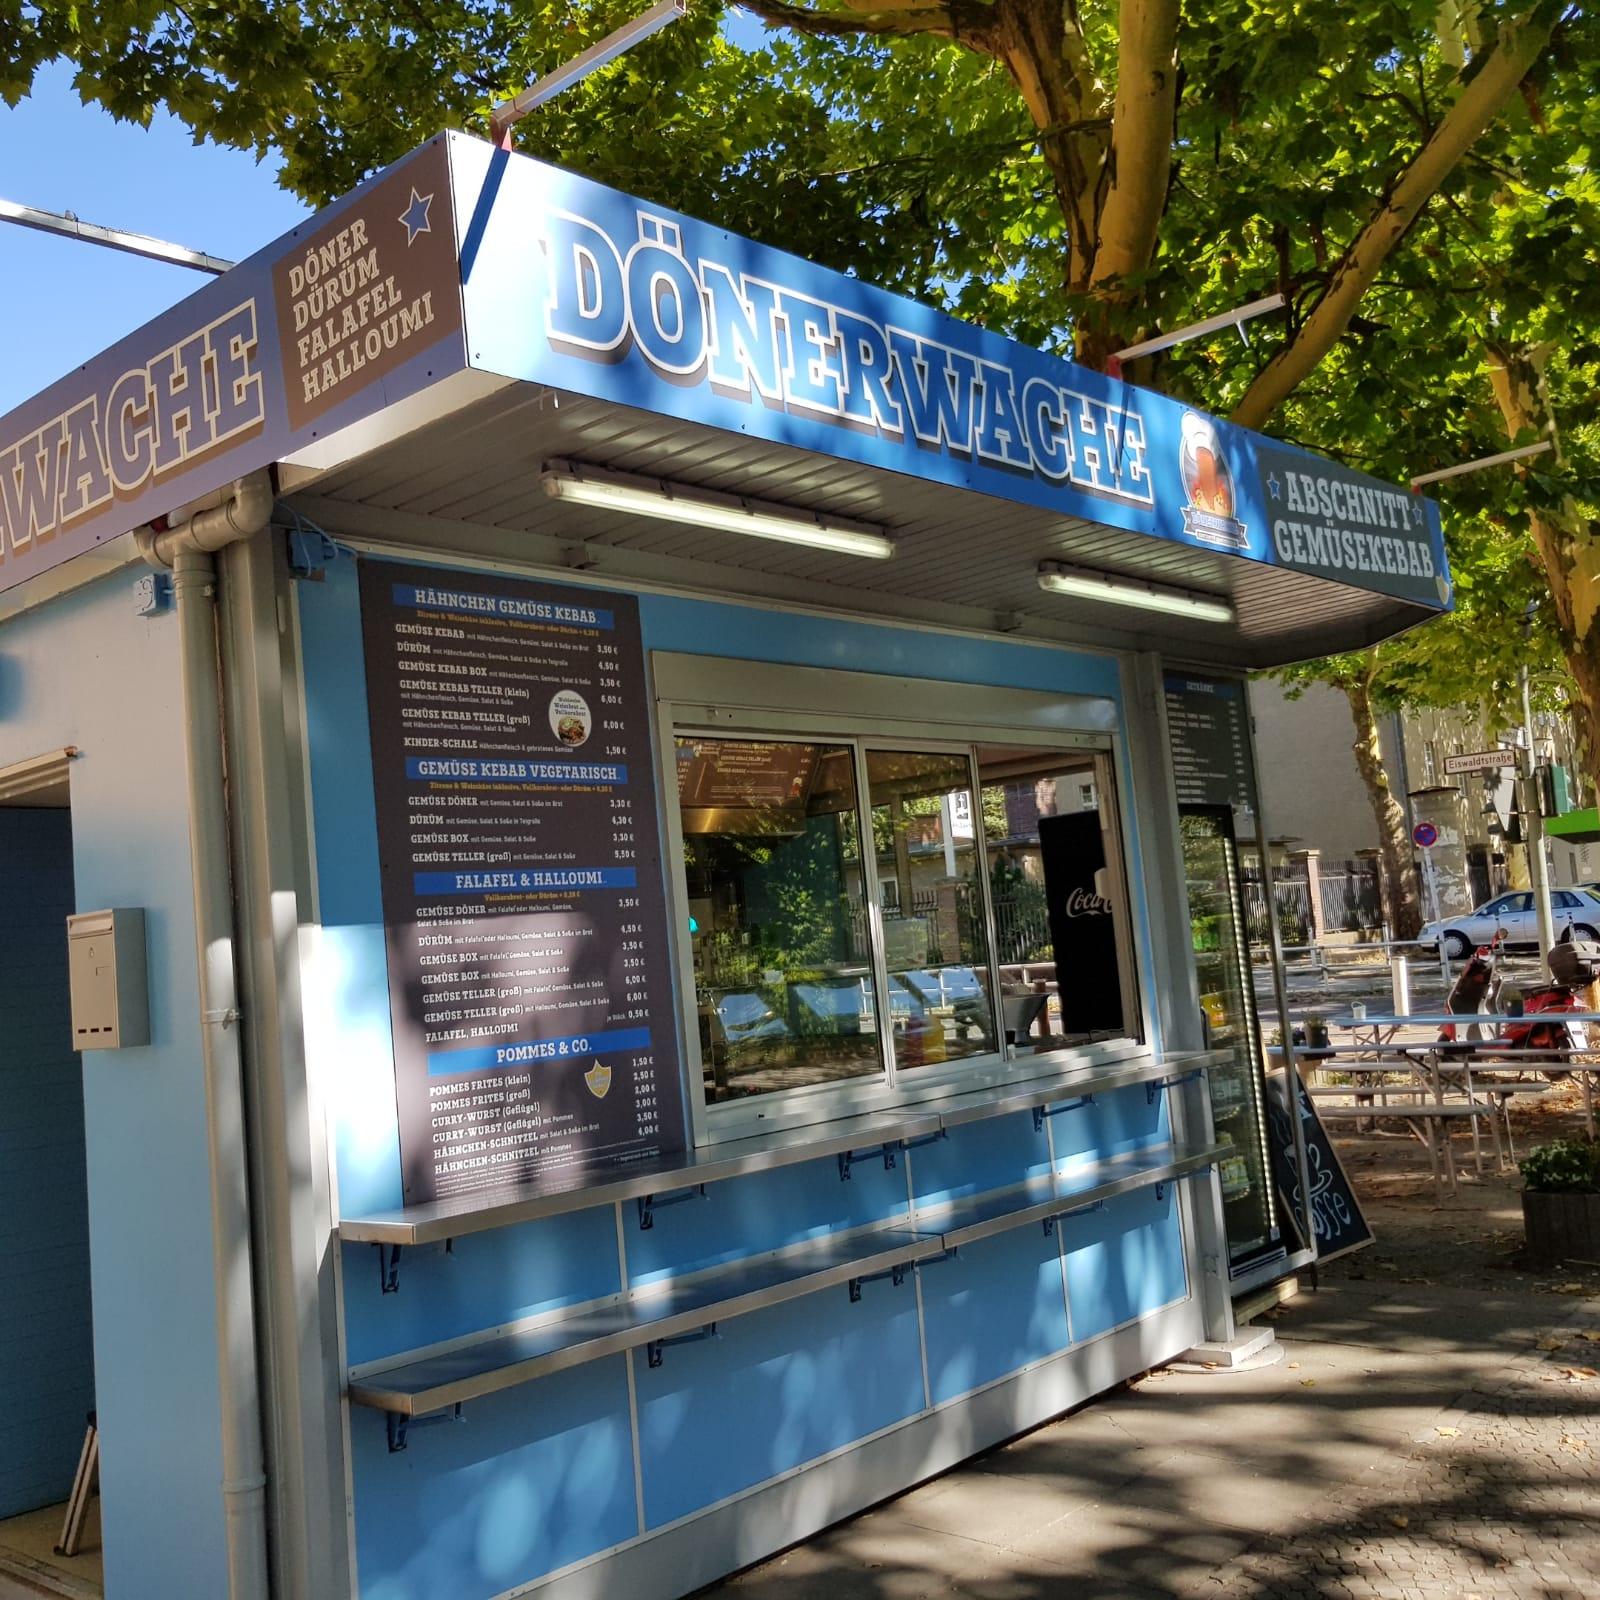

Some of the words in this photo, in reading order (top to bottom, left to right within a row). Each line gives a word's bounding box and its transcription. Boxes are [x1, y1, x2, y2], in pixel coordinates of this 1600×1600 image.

[288, 218, 369, 297] DÖNER
[292, 248, 380, 332] DÜRÜM
[297, 276, 402, 367] FALAFEL
[302, 291, 435, 404] HALLOUMI
[543, 210, 1154, 505] DÖNERWACHE
[0, 298, 265, 556] WACHE
[1285, 472, 1411, 531] ABSCHNITT
[1274, 519, 1434, 578] GEMÜSEKEBAB
[415, 587, 496, 611] HÄHNCHEN
[499, 597, 552, 618] GEMÜSE
[554, 607, 597, 624] KEBAB
[395, 622, 433, 636] GEMÜSE
[435, 628, 465, 639] KEBAB
[397, 641, 431, 654] DÜRÜM
[597, 645, 612, 654] 3,50
[398, 660, 436, 672] GEMÜSE
[438, 665, 468, 675] KEBAB
[469, 667, 488, 676] BOX
[598, 662, 613, 671] 4,50
[399, 678, 437, 691] GEMÜSE
[439, 683, 469, 693] KEBAB
[470, 685, 503, 695] TELLER
[504, 688, 529, 699] (klein)
[600, 678, 615, 688] 3,50
[402, 707, 439, 719] GEMÜSE
[441, 711, 471, 721] KEBAB
[473, 712, 505, 722] TELLER
[507, 715, 530, 726] (groß)
[404, 737, 478, 749] KINDER-SCHALE
[606, 747, 621, 756] 1,50
[1449, 753, 1512, 769] Eiswaldtstraße
[418, 759, 478, 776] GEMÜSE
[481, 763, 527, 777] KEBAB
[529, 765, 617, 780] VEGETARISCH
[408, 795, 446, 806] GEMÜSE
[448, 795, 478, 806] DÖNER
[410, 814, 444, 824] DÜRÜM
[411, 832, 449, 843] GEMÜSE
[451, 834, 469, 843] BOX
[412, 851, 450, 862] GEMÜSE
[452, 852, 485, 861] TELLER
[487, 853, 511, 862] (groß)
[455, 874, 517, 889] FALAFEL
[520, 874, 530, 886] &
[533, 871, 603, 886] HALLOUMI
[416, 905, 454, 917] GEMÜSE
[456, 904, 486, 915] DÖNER
[619, 899, 634, 908] 3,50
[419, 935, 453, 946] DÜRÜM
[622, 942, 638, 951] 3,50
[639, 941, 644, 949] €
[420, 953, 458, 965] GEMÜSE
[460, 953, 478, 963] BOX
[624, 959, 639, 968] 3,50
[640, 958, 645, 966] €
[421, 972, 459, 984] GEMÜSE
[461, 972, 480, 981] BOX
[422, 990, 460, 1004] GEMÜSE
[462, 989, 496, 1000] TELLER
[497, 986, 522, 998] (groß)
[643, 992, 648, 1000] €
[424, 1009, 462, 1023] GEMÜSE
[464, 1007, 497, 1019] TELLER
[499, 1005, 524, 1017] (groß)
[628, 1010, 644, 1019] 0,50
[425, 1029, 469, 1044] FALAFEL,
[470, 1023, 518, 1037] HALLOUMI
[497, 1043, 556, 1063] POMMES
[558, 1041, 569, 1055] &
[572, 1038, 592, 1053] CO.
[632, 1057, 648, 1068] 1,50
[429, 1082, 470, 1097] POMMES
[471, 1078, 503, 1091] FRITES
[505, 1074, 531, 1087] (klein)
[651, 1084, 656, 1092] €
[431, 1098, 471, 1113] POMMES
[473, 1093, 504, 1106] FRITES
[506, 1089, 530, 1102] (groß)
[432, 1108, 501, 1128] CURRY-WURST
[502, 1102, 540, 1117] (Geflügel)
[637, 1112, 652, 1123] 3,50
[654, 1111, 658, 1119] €
[433, 1123, 502, 1143] CURRY-WURST
[504, 1117, 542, 1133] (Geflügel)
[655, 1125, 660, 1133] €
[434, 1131, 538, 1159] HÄHNCHEN-SCHNITZEL
[435, 1146, 539, 1175] HÄHNCHEN-SCHNITZEL
